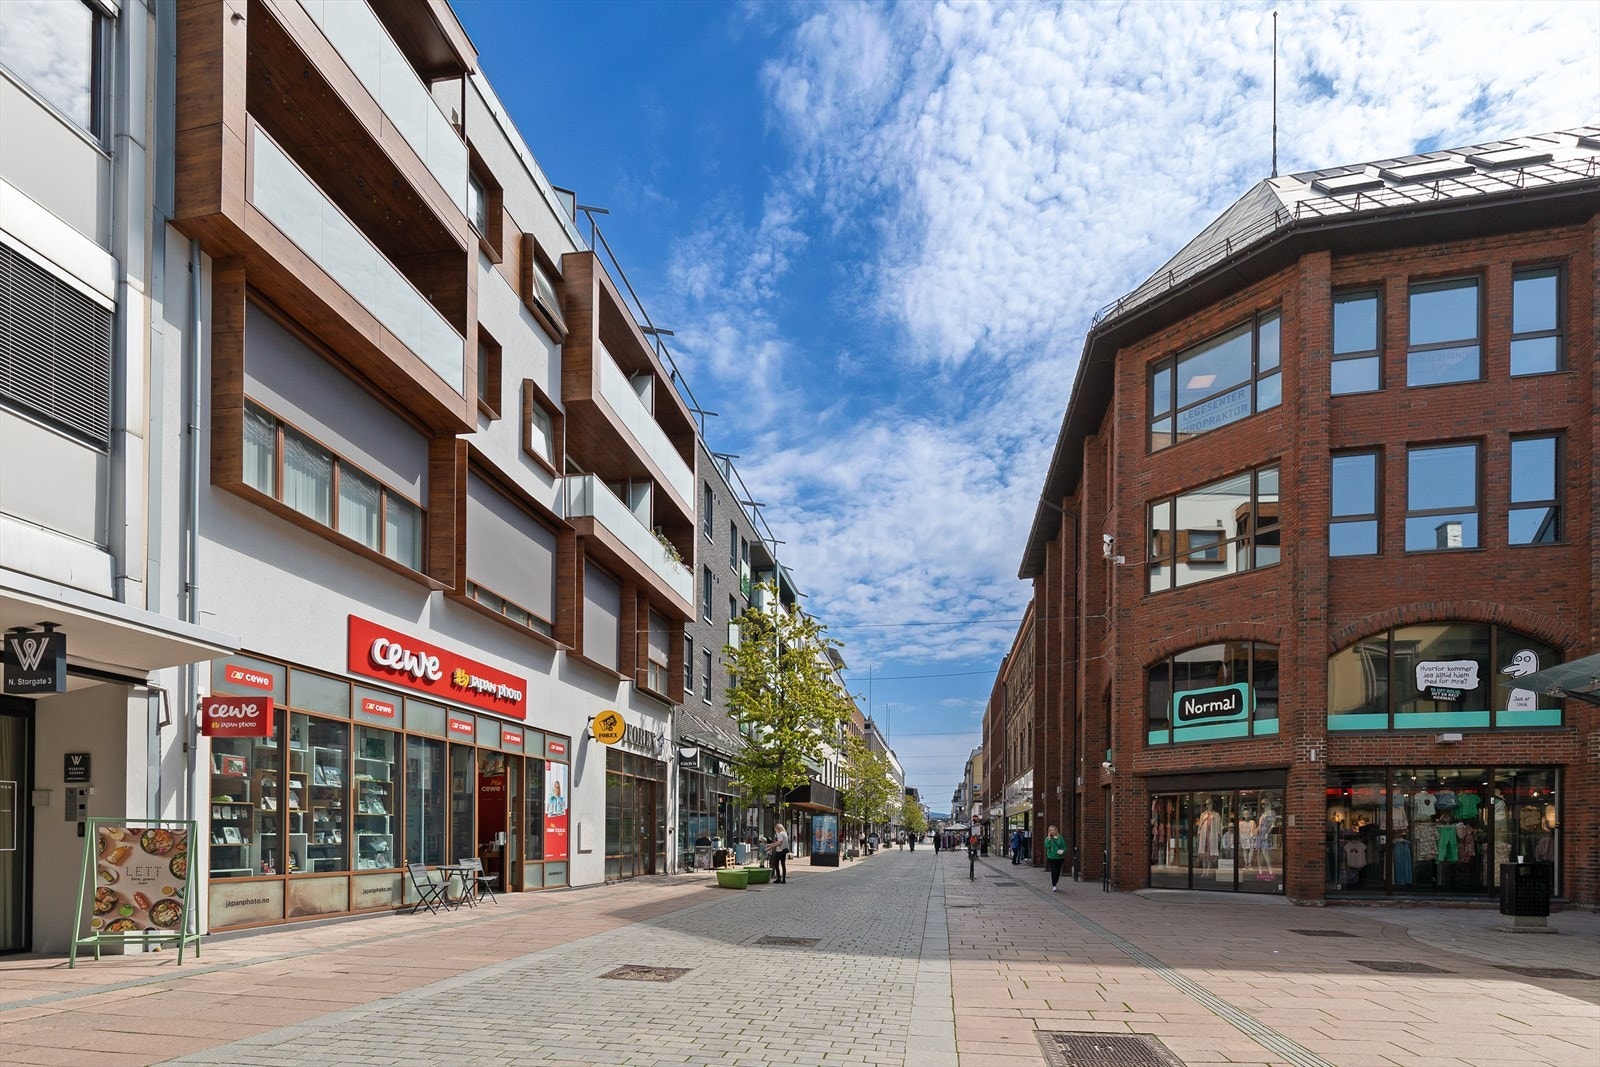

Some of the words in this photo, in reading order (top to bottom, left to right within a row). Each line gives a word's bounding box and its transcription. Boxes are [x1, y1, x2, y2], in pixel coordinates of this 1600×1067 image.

[1183, 389, 1245, 421] LEGESENTER
[371, 637, 443, 681] cewe
[8, 678, 16, 686] N.
[17, 677, 47, 687] Storgate
[47, 677, 52, 685] 3
[245, 673, 270, 686] cewe
[1450, 677, 1468, 685] mye?
[375, 704, 393, 714] cewe
[1185, 694, 1236, 716] Normal
[208, 703, 260, 719] cewe
[458, 723, 472, 732] cewe
[510, 735, 521, 743] cewe
[626, 723, 656, 750] FOREX
[125, 866, 162, 877] LETT
[362, 887, 393, 895] japanphoto.no
[225, 898, 270, 908] japanphoto.no
